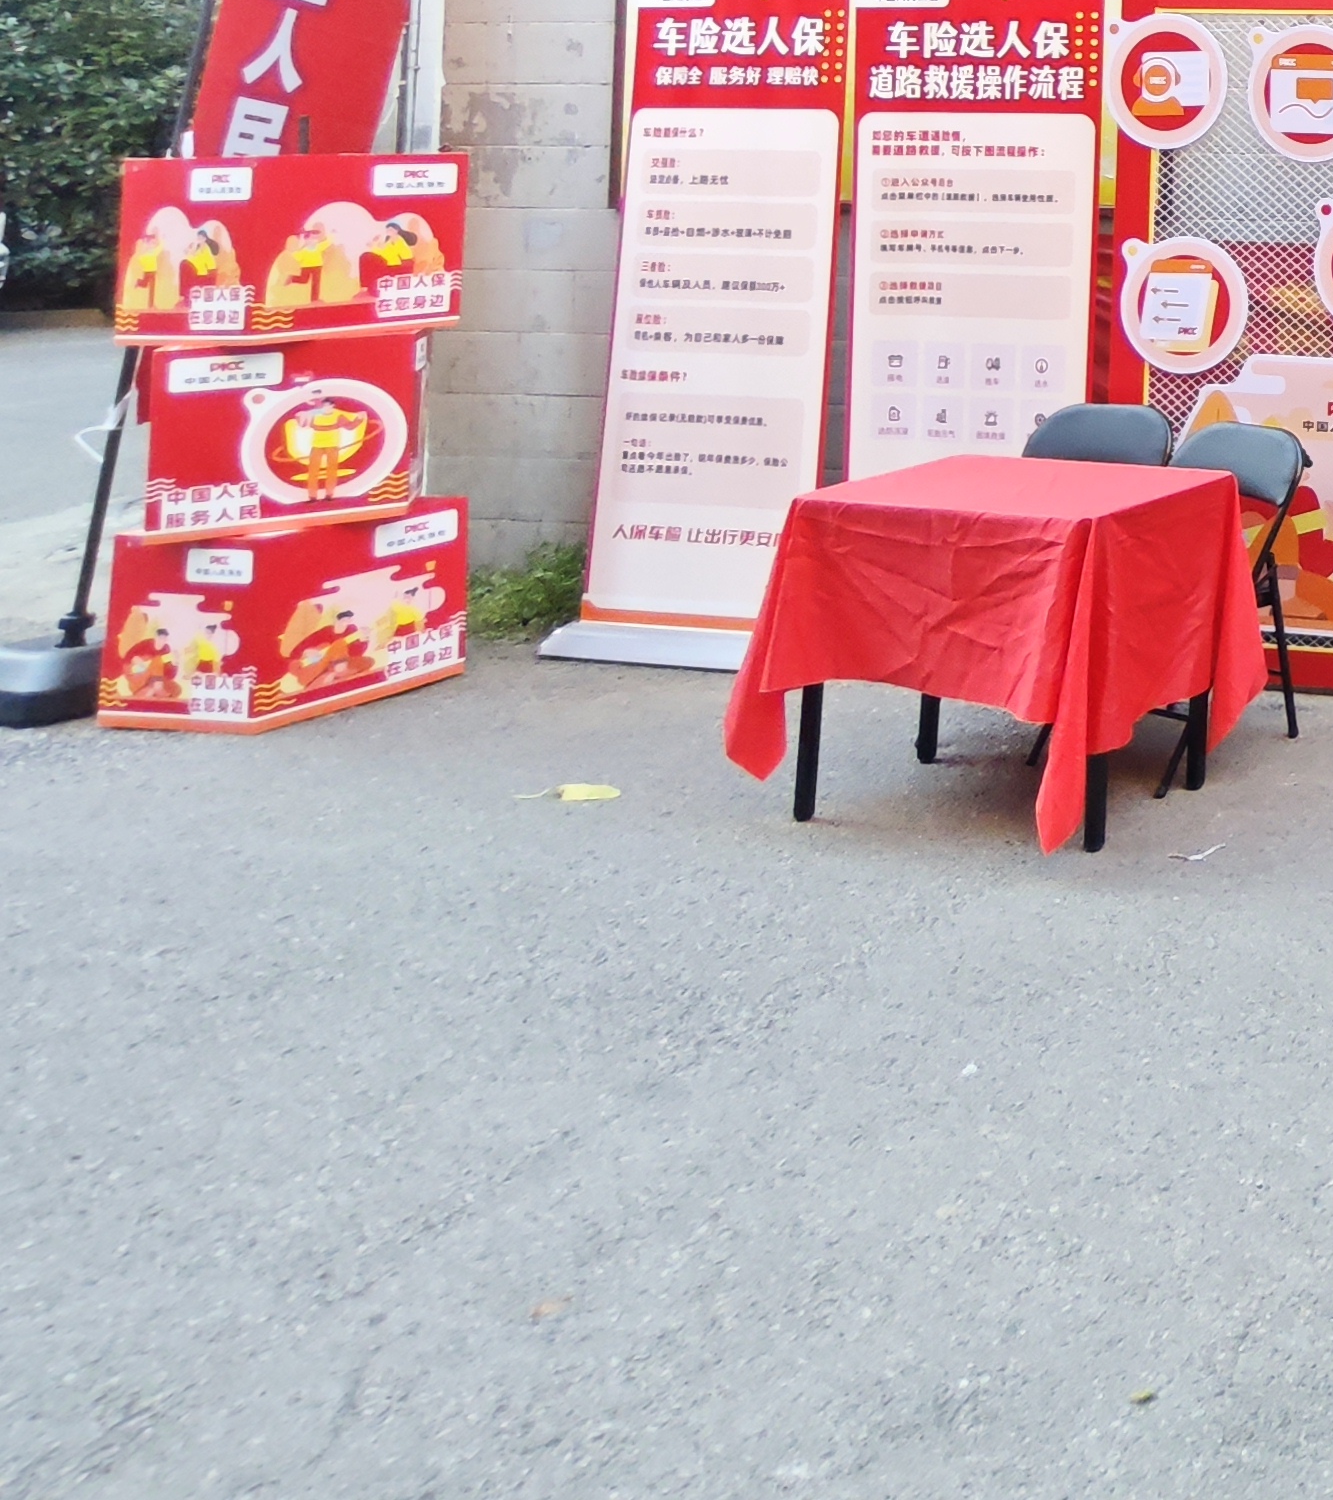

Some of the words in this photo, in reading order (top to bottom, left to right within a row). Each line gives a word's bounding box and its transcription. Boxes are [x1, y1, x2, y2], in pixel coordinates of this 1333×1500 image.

[652, 17, 826, 56] 车险选人保
[884, 21, 1069, 60] 车险选人保
[655, 66, 702, 86] 保障全
[709, 66, 761, 86] 服务好
[767, 65, 819, 86] 理赔快
[869, 64, 1085, 102] 道路救援操作流程
[403, 169, 429, 179] PICC
[378, 274, 446, 292] 中国人保
[209, 360, 245, 372] PICC
[166, 482, 259, 504] 中国人保
[166, 505, 259, 529] 服务人民
[612, 523, 683, 543] 人保车险
[687, 527, 781, 548] 让出行更安
[387, 624, 454, 654] 中国人保
